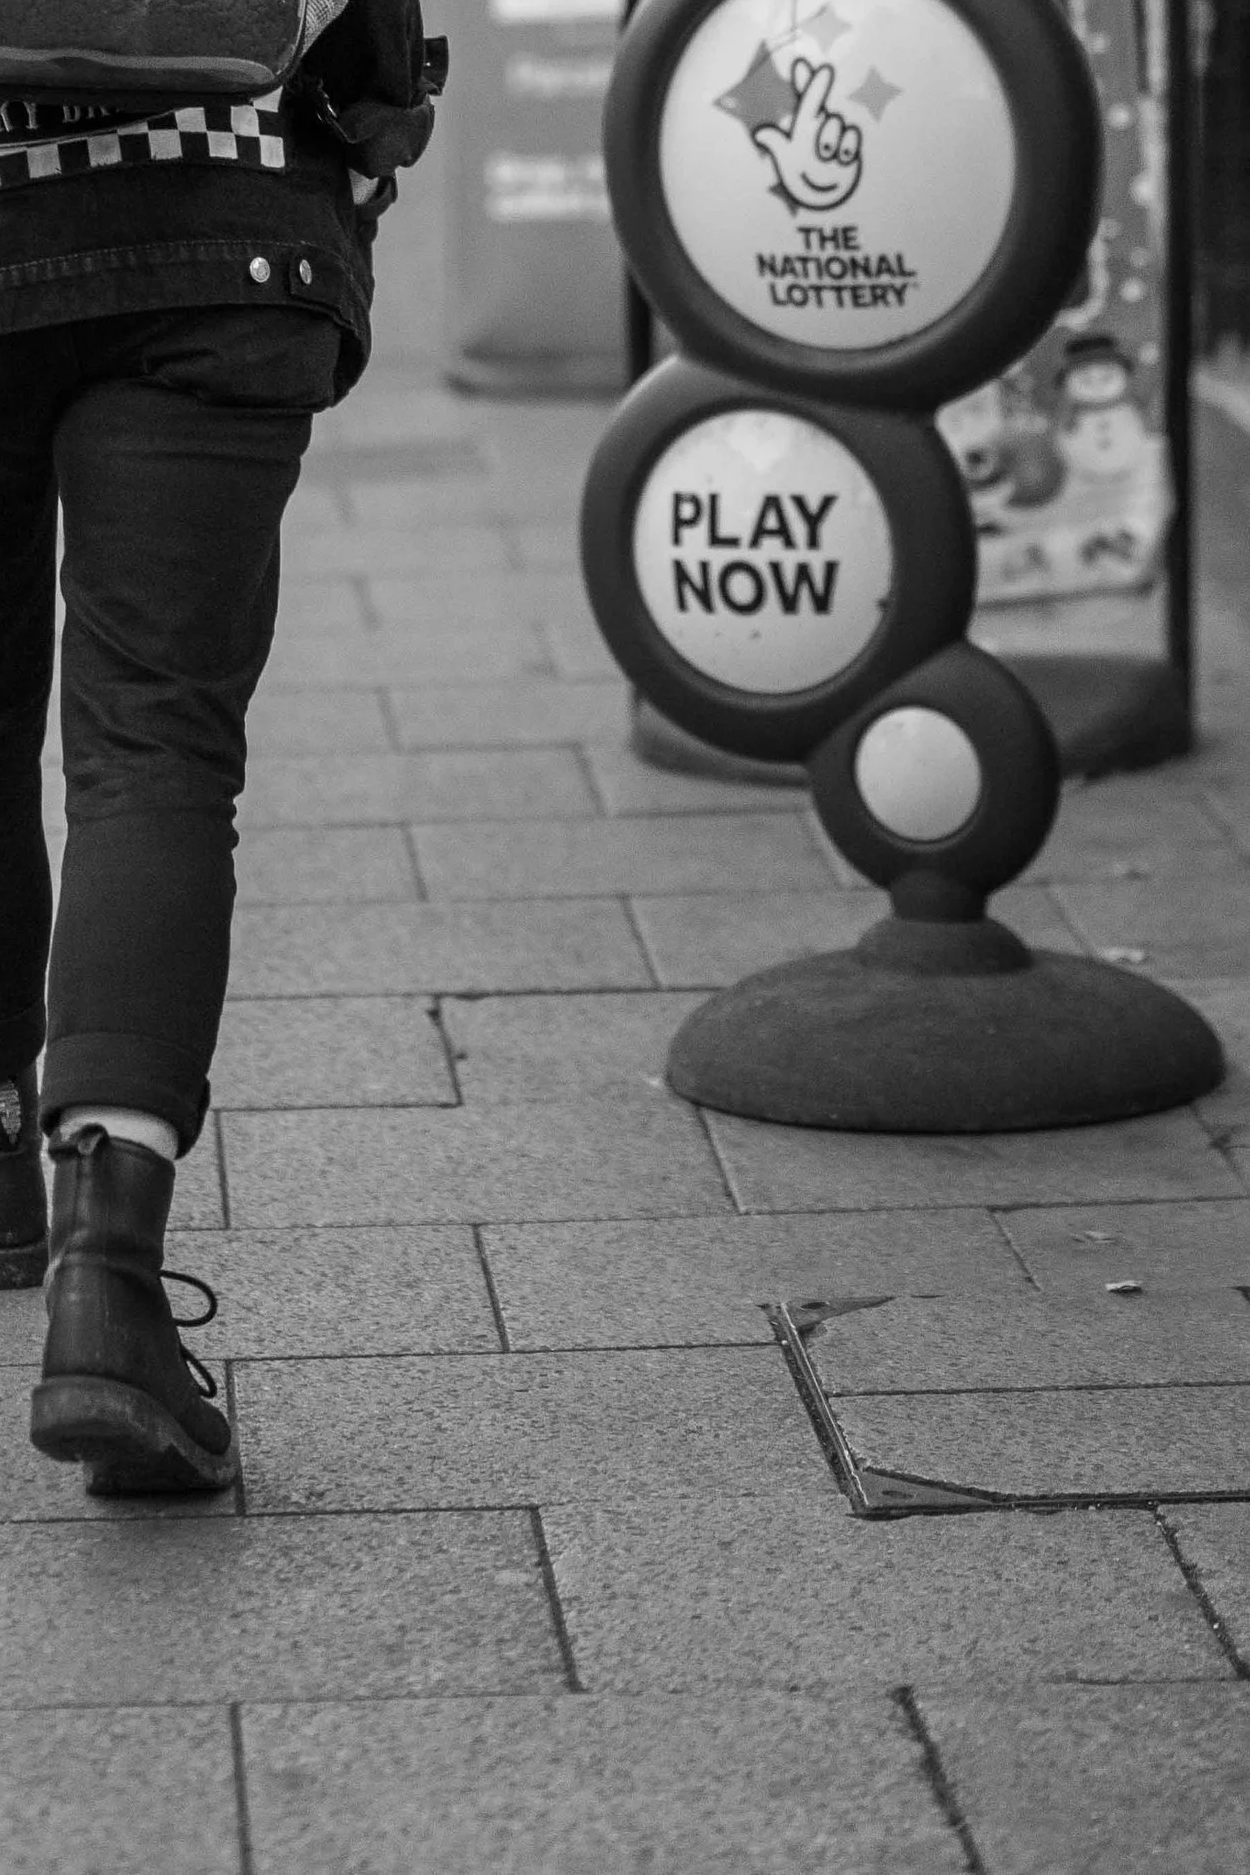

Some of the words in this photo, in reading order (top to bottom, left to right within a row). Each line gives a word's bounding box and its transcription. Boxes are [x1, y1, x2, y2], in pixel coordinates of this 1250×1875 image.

[797, 225, 860, 250] THE
[756, 250, 917, 279] NATIONAL
[768, 282, 909, 309] LOTTERY
[672, 491, 839, 551] PLAY
[673, 558, 839, 616] NOW
